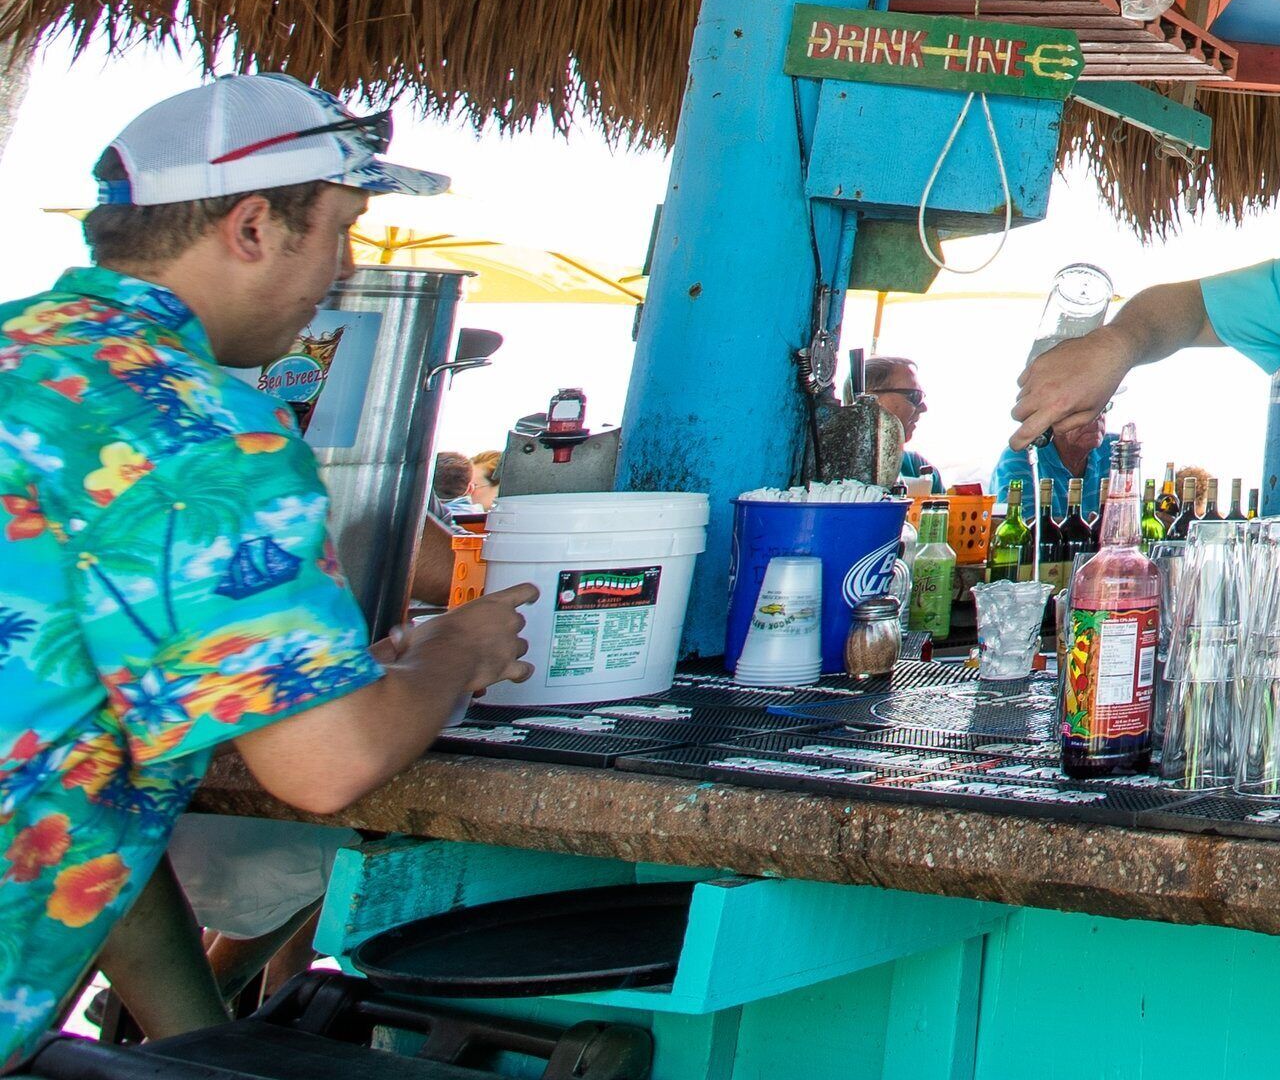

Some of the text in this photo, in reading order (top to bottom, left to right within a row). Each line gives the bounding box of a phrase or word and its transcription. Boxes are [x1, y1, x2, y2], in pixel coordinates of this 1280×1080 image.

[807, 20, 1028, 78] DRINK LINE
[257, 369, 329, 391] Sea Breeze
